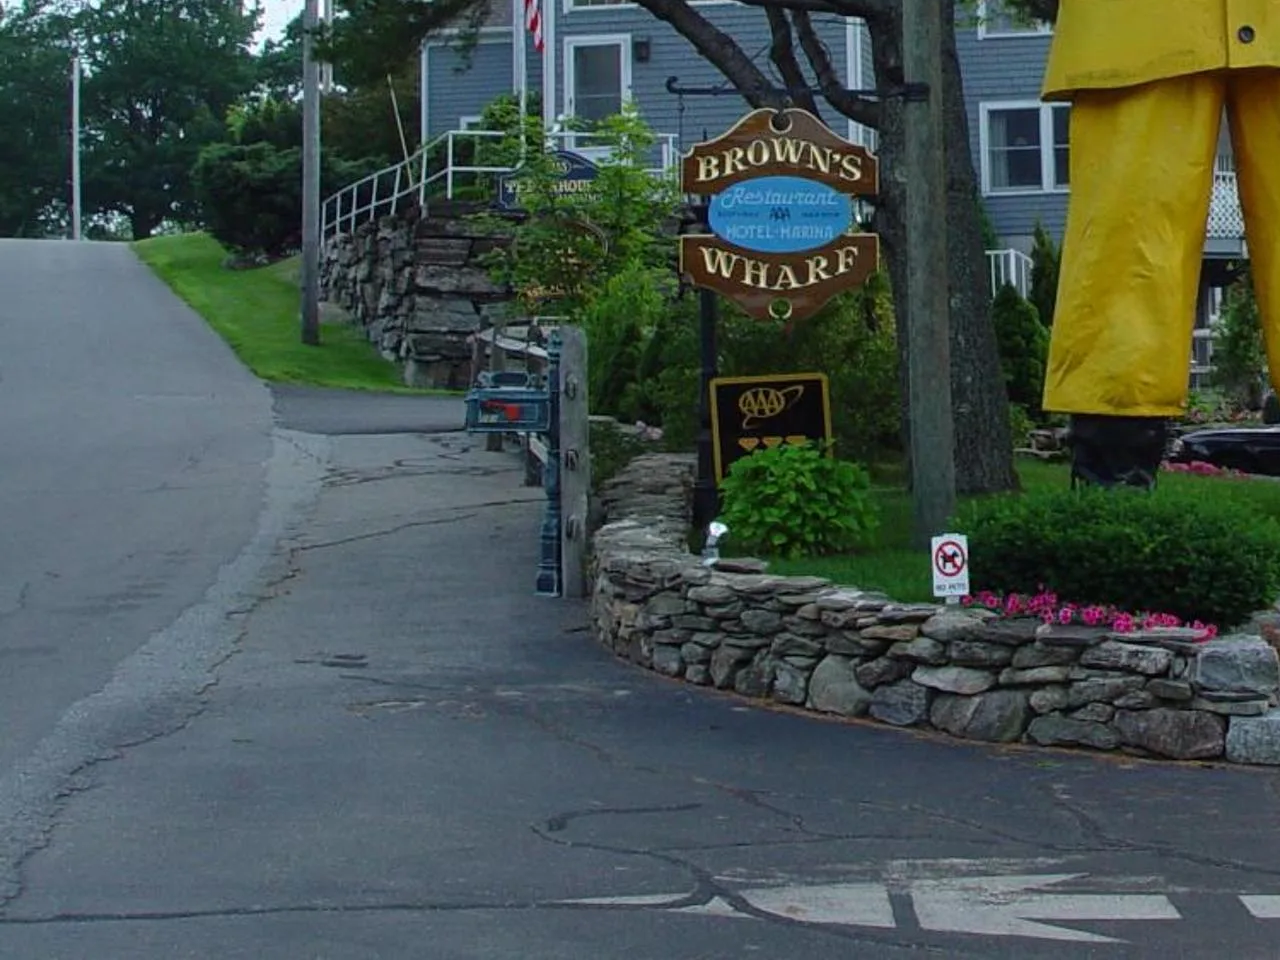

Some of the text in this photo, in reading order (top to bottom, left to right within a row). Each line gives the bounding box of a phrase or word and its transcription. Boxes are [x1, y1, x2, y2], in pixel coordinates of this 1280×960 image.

[696, 138, 862, 182] BROWN'S
[721, 187, 839, 209] Restaurant
[699, 246, 860, 290] WHARF
[743, 390, 781, 414] AAA
